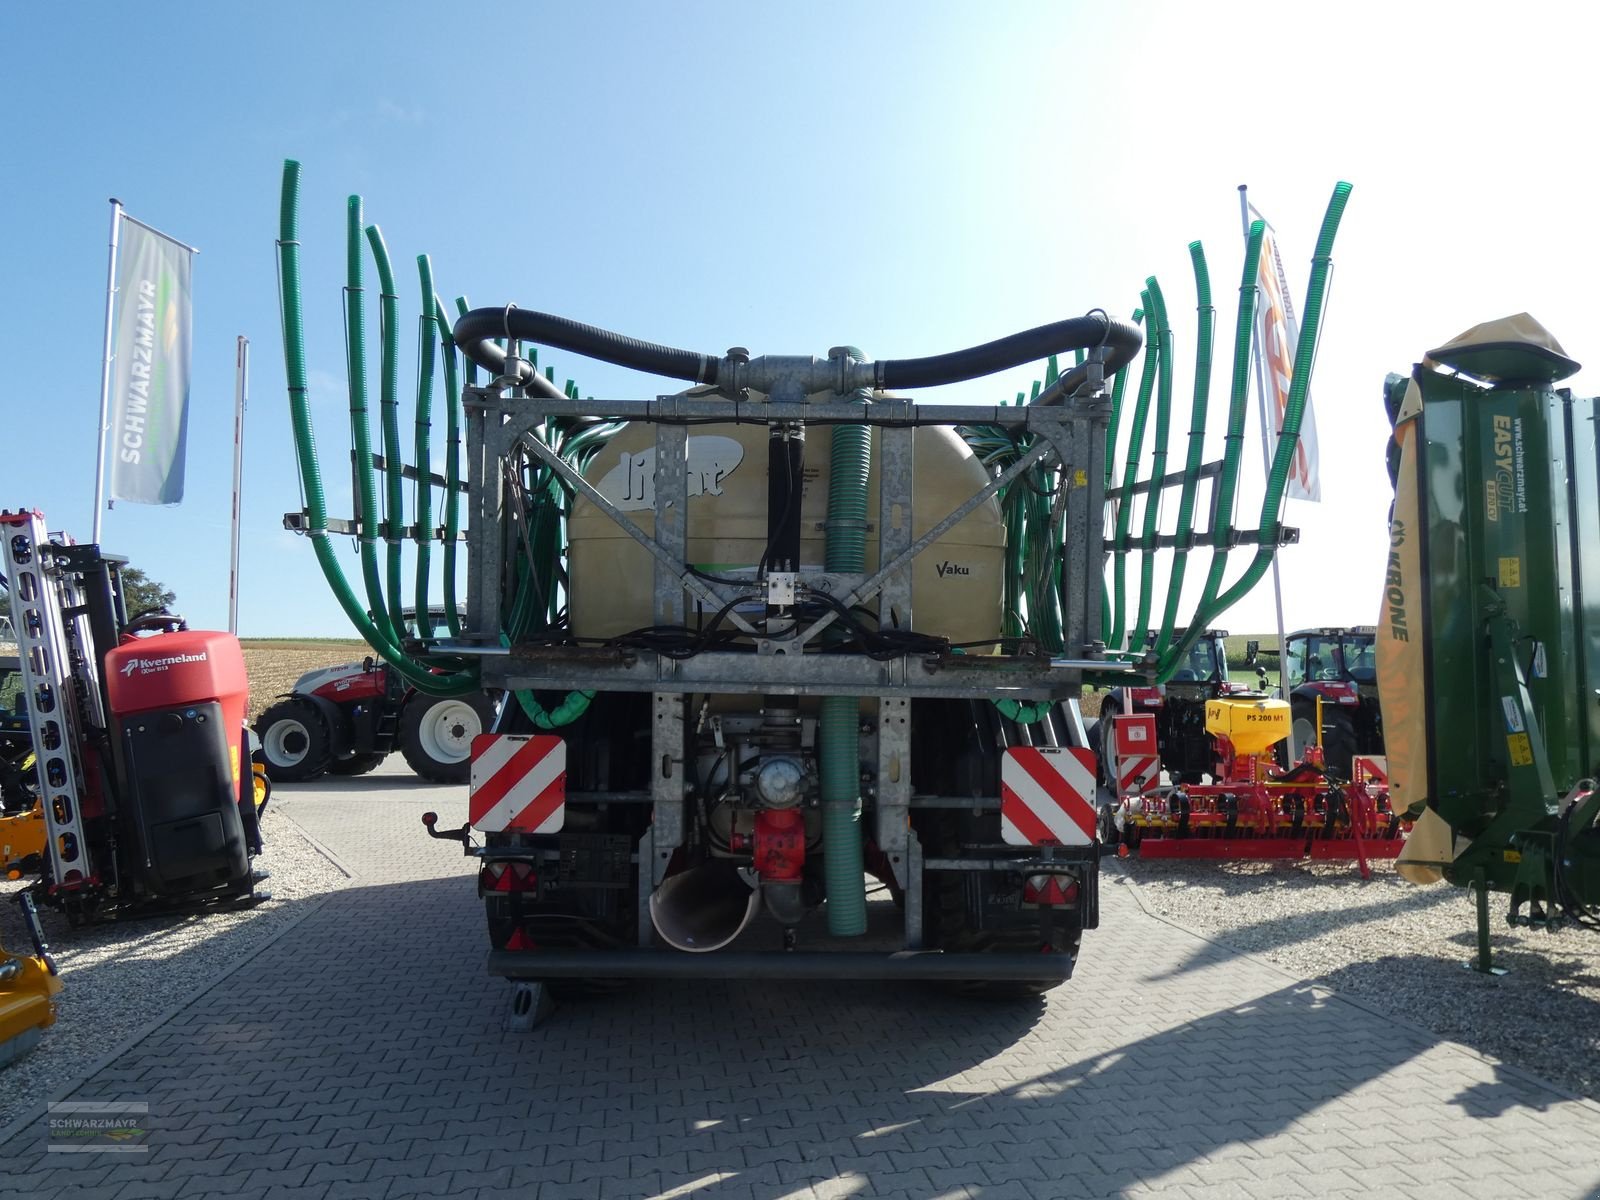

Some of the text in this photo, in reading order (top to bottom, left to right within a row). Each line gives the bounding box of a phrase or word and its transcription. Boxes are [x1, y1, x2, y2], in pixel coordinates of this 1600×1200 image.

[120, 279, 157, 465] SCHWARZMAYR
[1514, 417, 1528, 513] www.schwarzmayr.at
[936, 561, 969, 578] Vaku
[1387, 551, 1409, 642] KRONE
[139, 652, 207, 668] Kverneland
[1247, 714, 1284, 722] PS 200 M1
